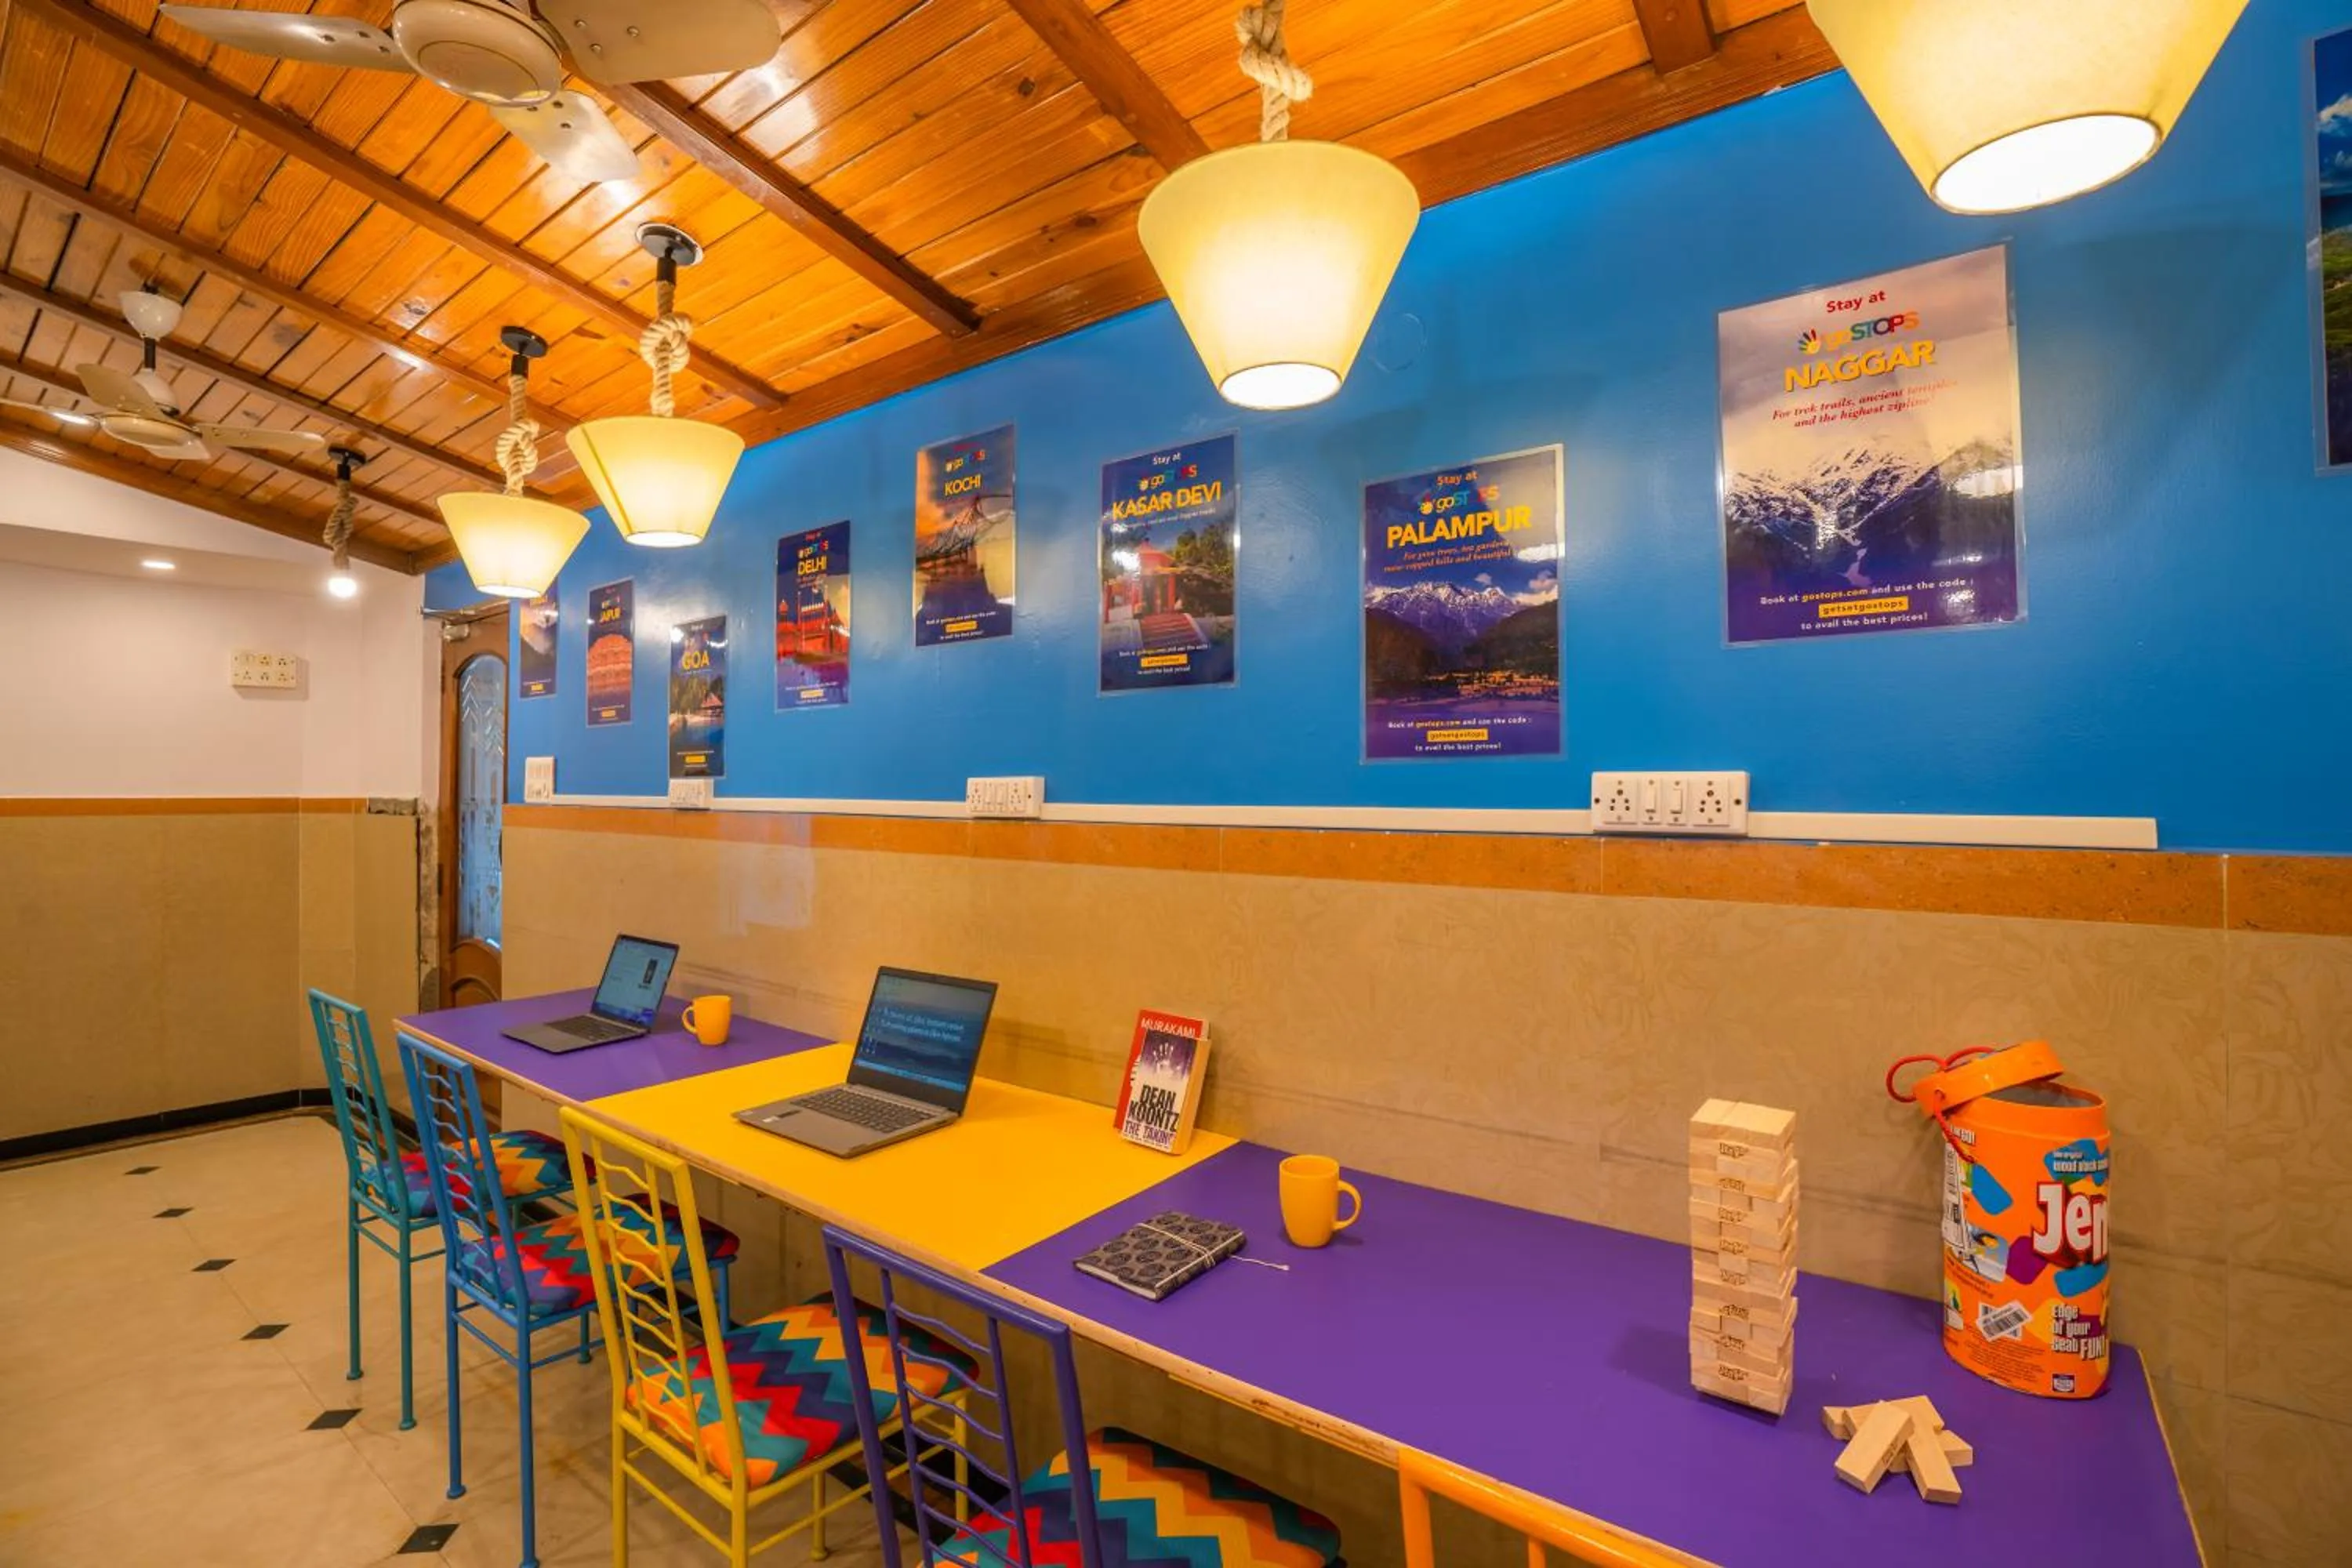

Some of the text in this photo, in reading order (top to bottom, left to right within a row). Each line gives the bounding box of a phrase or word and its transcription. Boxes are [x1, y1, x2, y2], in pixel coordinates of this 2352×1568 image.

[1827, 291, 1886, 313] Stay at
[1784, 339, 1936, 393] NAGGAR
[1794, 416, 1817, 427] and
[1819, 413, 1837, 423] the
[1840, 405, 1884, 420] highest
[945, 474, 982, 495] KOCHI
[1112, 492, 1173, 521] KASAR
[1176, 481, 1221, 508] DEVI
[1435, 485, 1500, 514] goSTPS
[1387, 505, 1532, 549] PALAMPUR
[797, 555, 828, 575] DELHI
[1760, 595, 1785, 604] Book
[1788, 594, 1798, 603] at
[1802, 589, 1868, 603] gostops.com
[1871, 584, 1890, 594] and
[1917, 582, 1935, 590] the
[1939, 578, 1966, 588] code
[1815, 619, 1838, 630] avail
[1842, 618, 1860, 627] the
[1863, 616, 1888, 626] best
[1890, 612, 1928, 625] prices!
[682, 650, 710, 670] GOA
[1142, 1018, 1196, 1039] MURAKAMI
[1140, 1083, 1177, 1111] DEAN
[1127, 1100, 1179, 1132] KOONTZ
